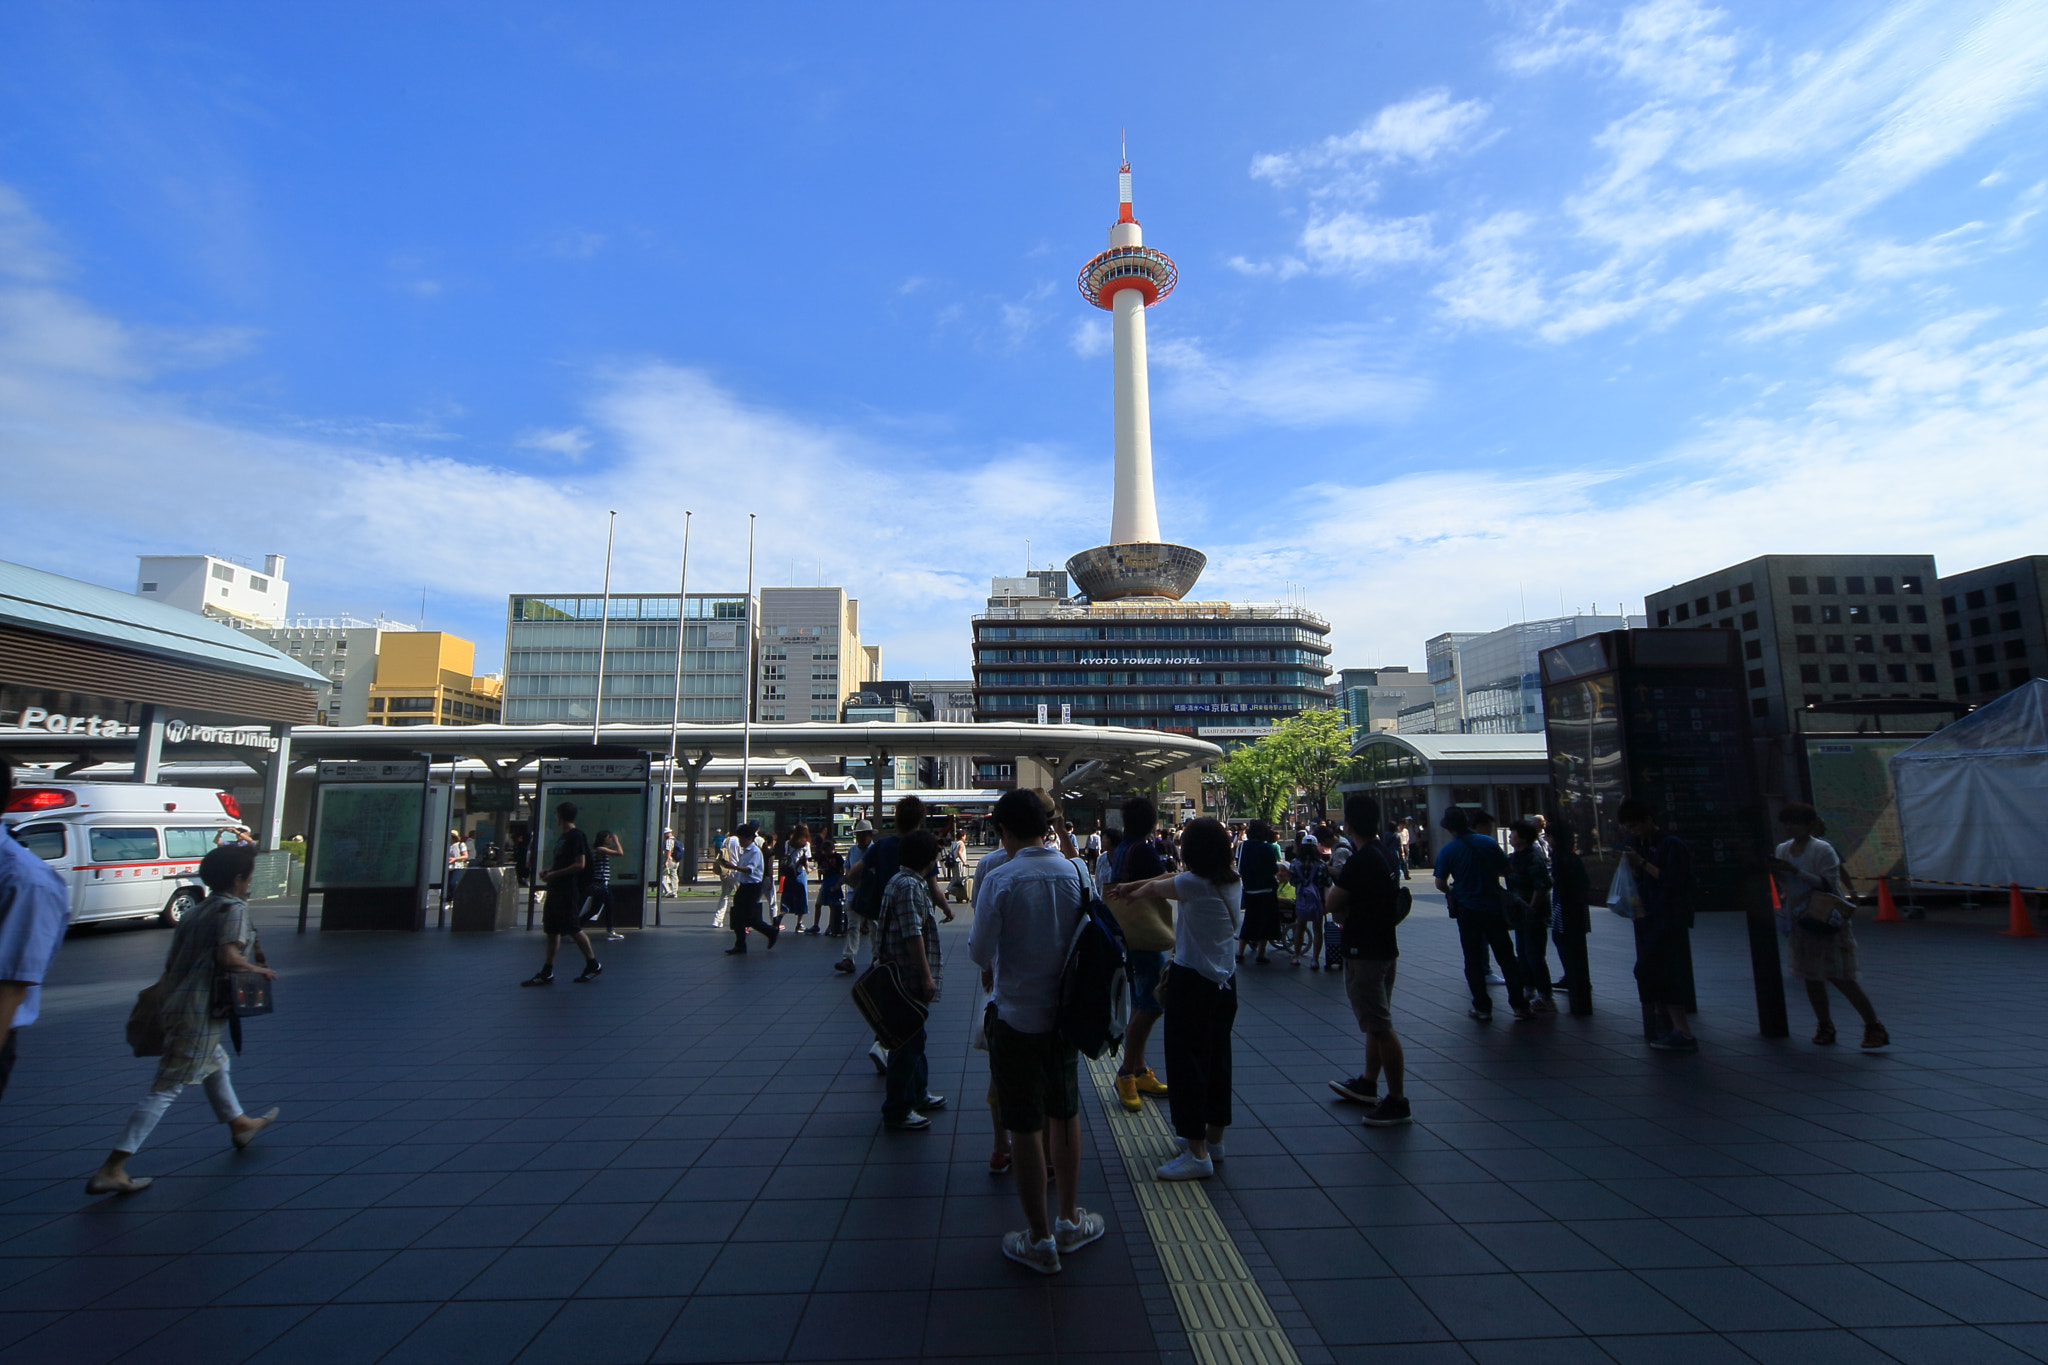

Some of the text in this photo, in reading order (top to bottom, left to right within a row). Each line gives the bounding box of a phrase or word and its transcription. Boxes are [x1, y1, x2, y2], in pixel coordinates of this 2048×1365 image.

[1080, 657, 1202, 665] KYOTO TOWER HOTEL
[19, 706, 120, 738] Porta
[191, 724, 280, 753] Porta Dining
